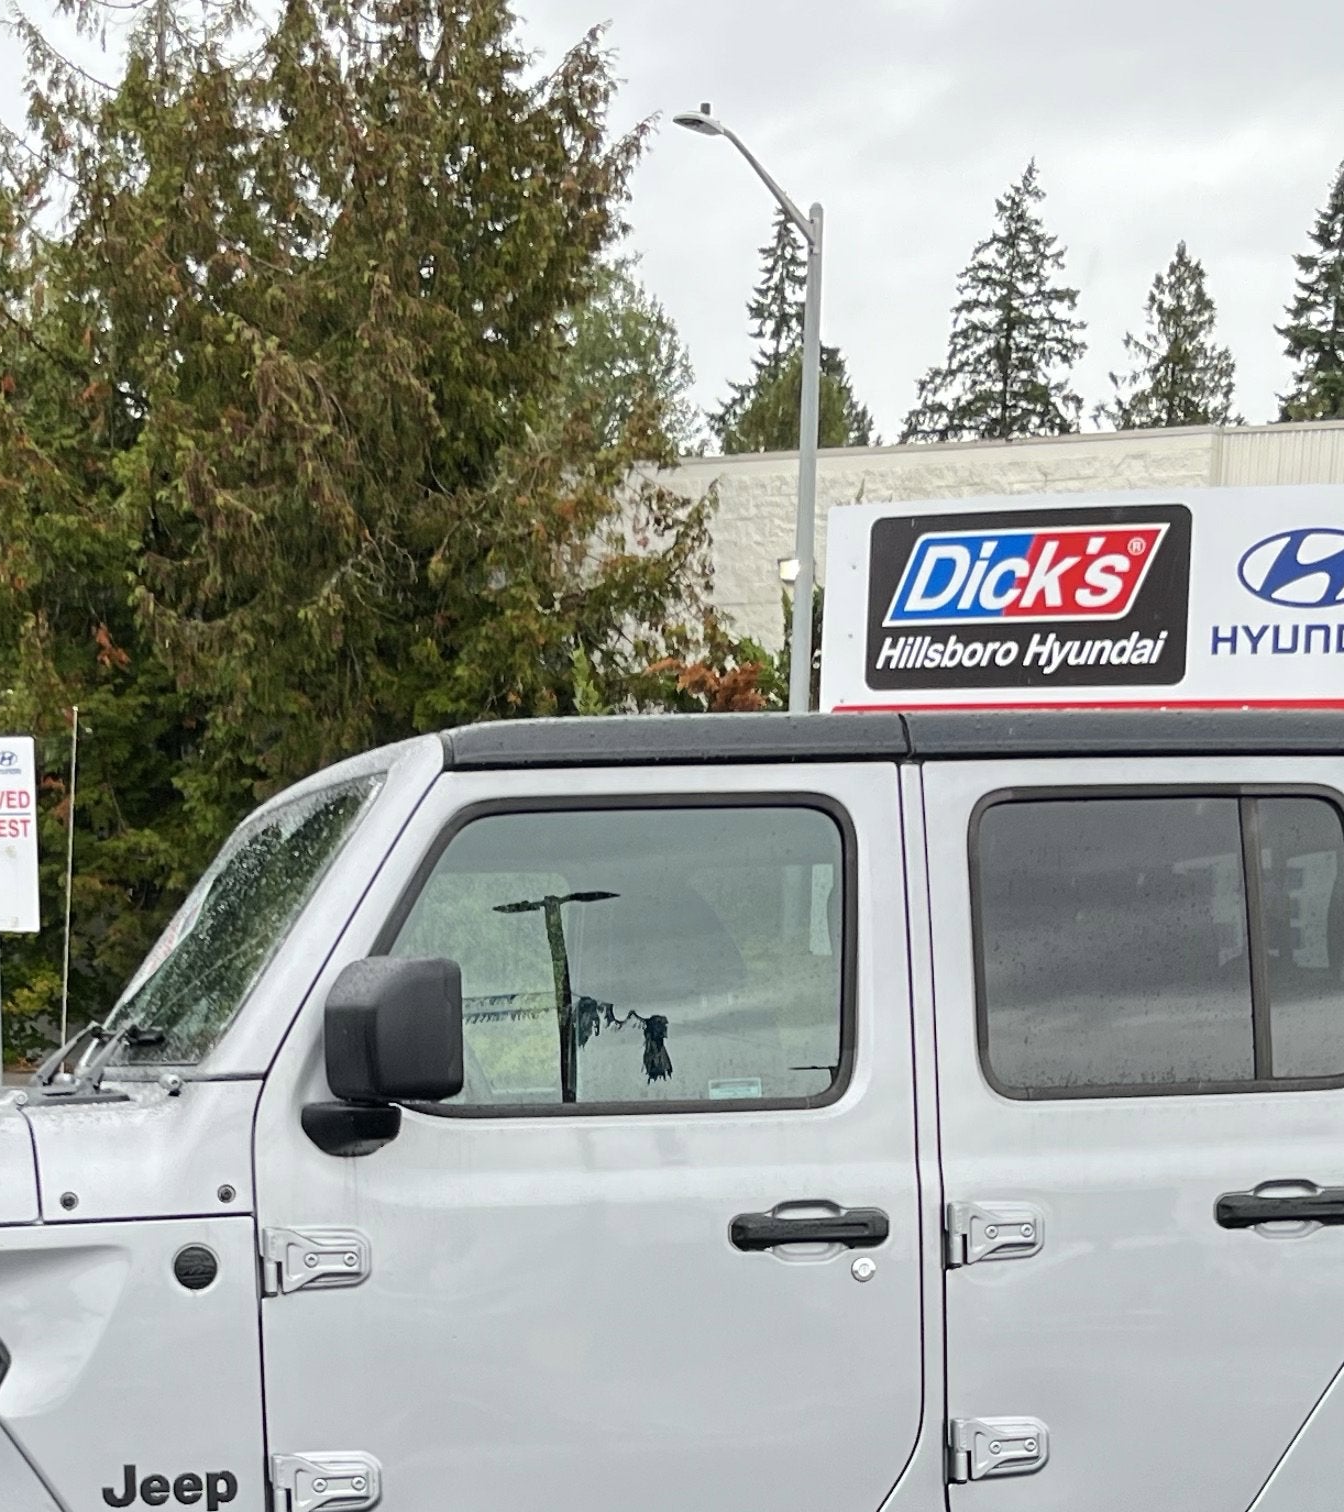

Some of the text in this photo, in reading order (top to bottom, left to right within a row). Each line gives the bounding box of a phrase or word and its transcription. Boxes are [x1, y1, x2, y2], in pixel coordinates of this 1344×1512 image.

[903, 536, 1131, 614] Dick's
[875, 630, 1168, 675] Hillsboro Hyundai
[102, 1464, 238, 1512] Jeep
